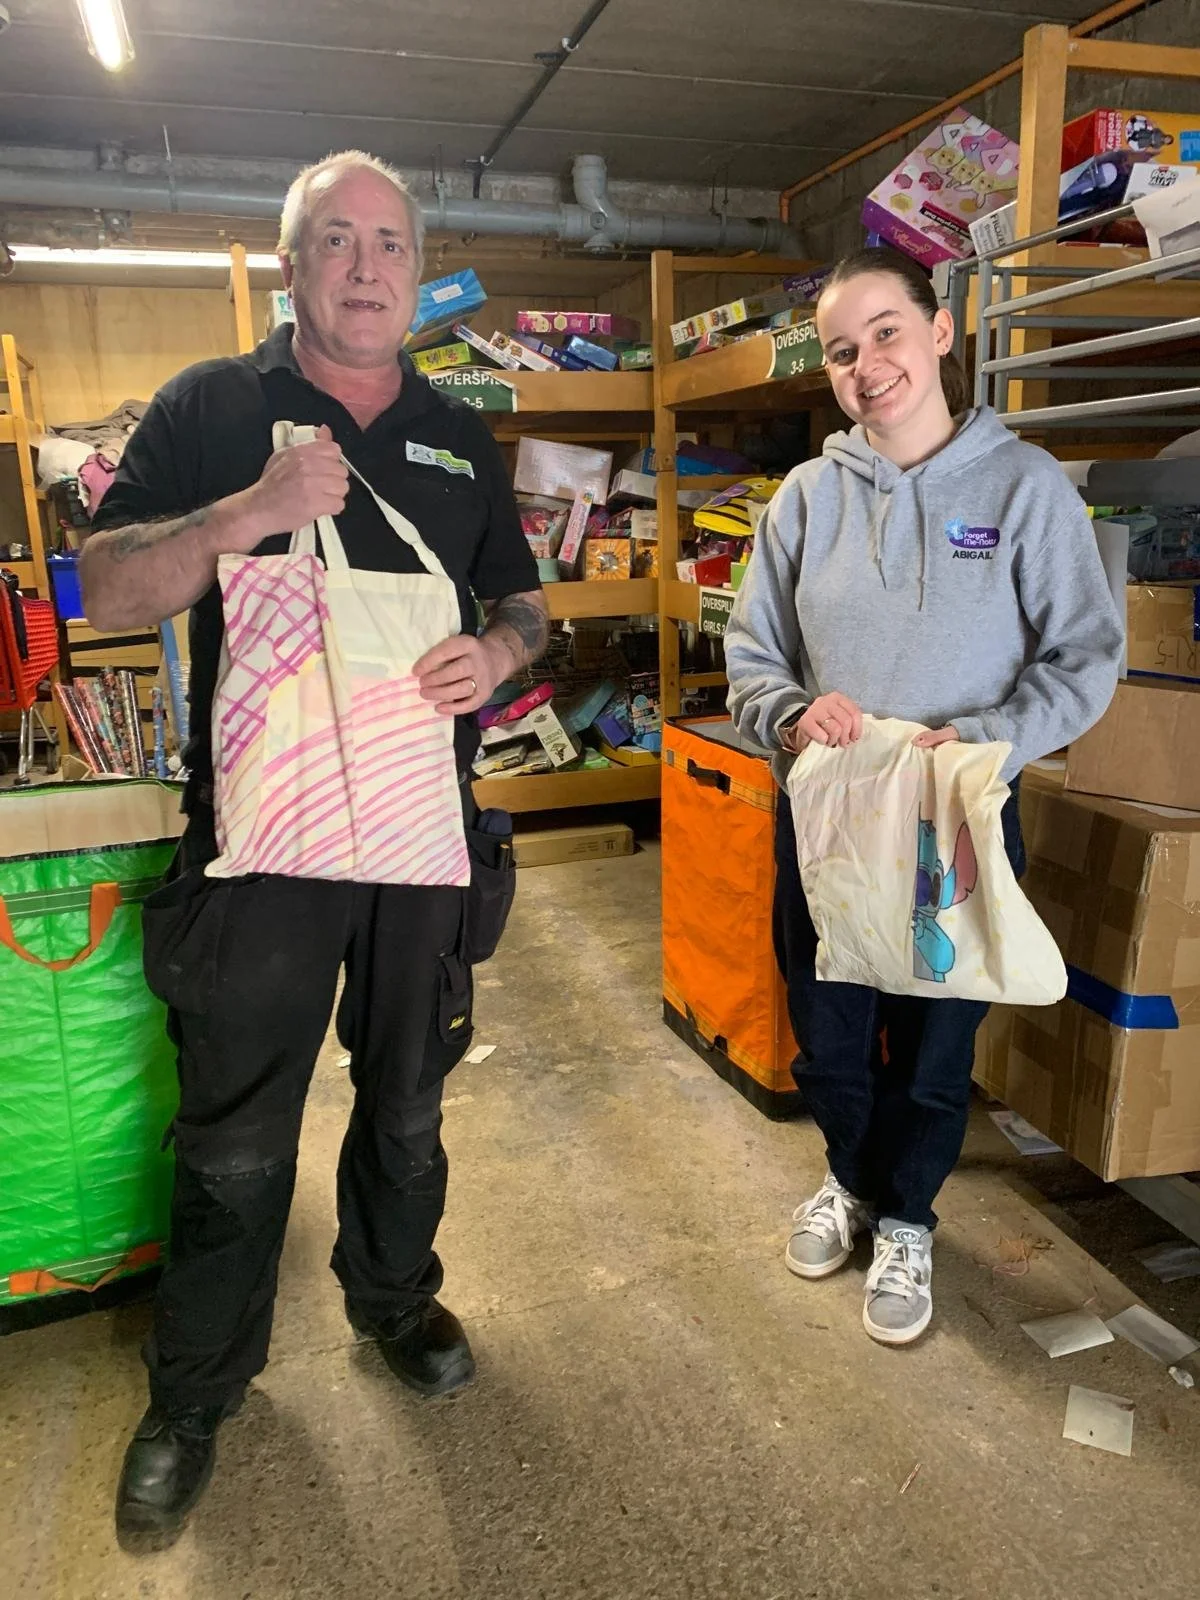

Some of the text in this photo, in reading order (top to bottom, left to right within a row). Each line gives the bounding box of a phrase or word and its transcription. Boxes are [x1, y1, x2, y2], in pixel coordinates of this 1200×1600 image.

[790, 358, 805, 375] 3-5
[964, 532, 988, 540] Forget
[952, 550, 993, 560] ABIGAIL
[703, 620, 721, 635] GIRLS
